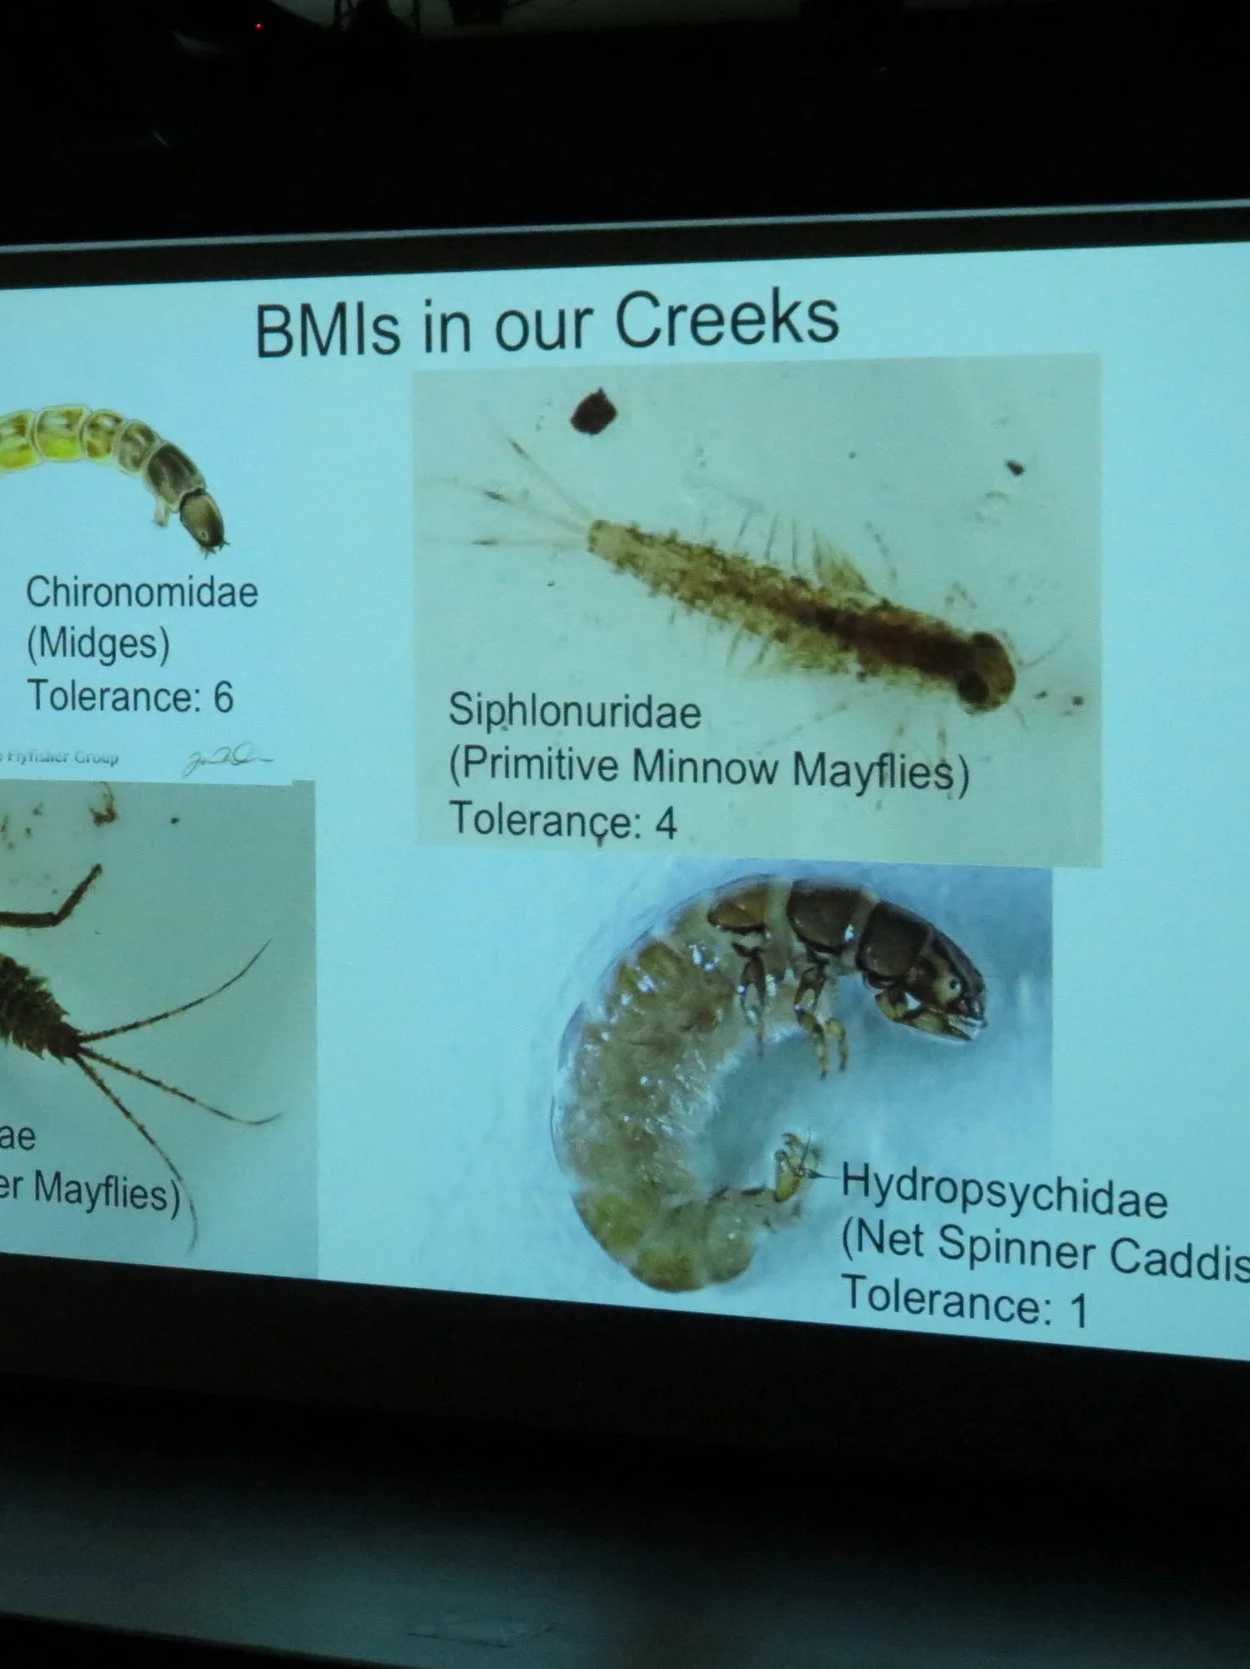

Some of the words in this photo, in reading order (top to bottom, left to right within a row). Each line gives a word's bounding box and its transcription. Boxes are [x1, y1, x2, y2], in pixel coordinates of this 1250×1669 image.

[256, 301, 401, 358] BMIs
[424, 298, 471, 353] in
[494, 307, 594, 352] our
[616, 287, 840, 348] Creeks
[26, 575, 259, 607] Chironomidae
[27, 625, 170, 667] (Midges)
[27, 678, 201, 713] Tolerance:
[213, 680, 234, 713] 6
[449, 691, 702, 734] Siphlonuridae
[7, 750, 68, 765] Flyfisher
[74, 750, 119, 767] Group
[450, 744, 619, 787] (Primitive
[633, 748, 779, 785] Minnow
[793, 751, 971, 799] Mayflies)
[450, 800, 642, 839] Tolerance:
[655, 806, 678, 840] 4
[35, 1169, 181, 1221] Mayflies)
[842, 1161, 1169, 1220] Hydropsychidae
[842, 1217, 924, 1261] (Net
[938, 1223, 1097, 1271] Spinner
[841, 1273, 1051, 1327] Tolerance:
[1070, 1293, 1087, 1328] 1
